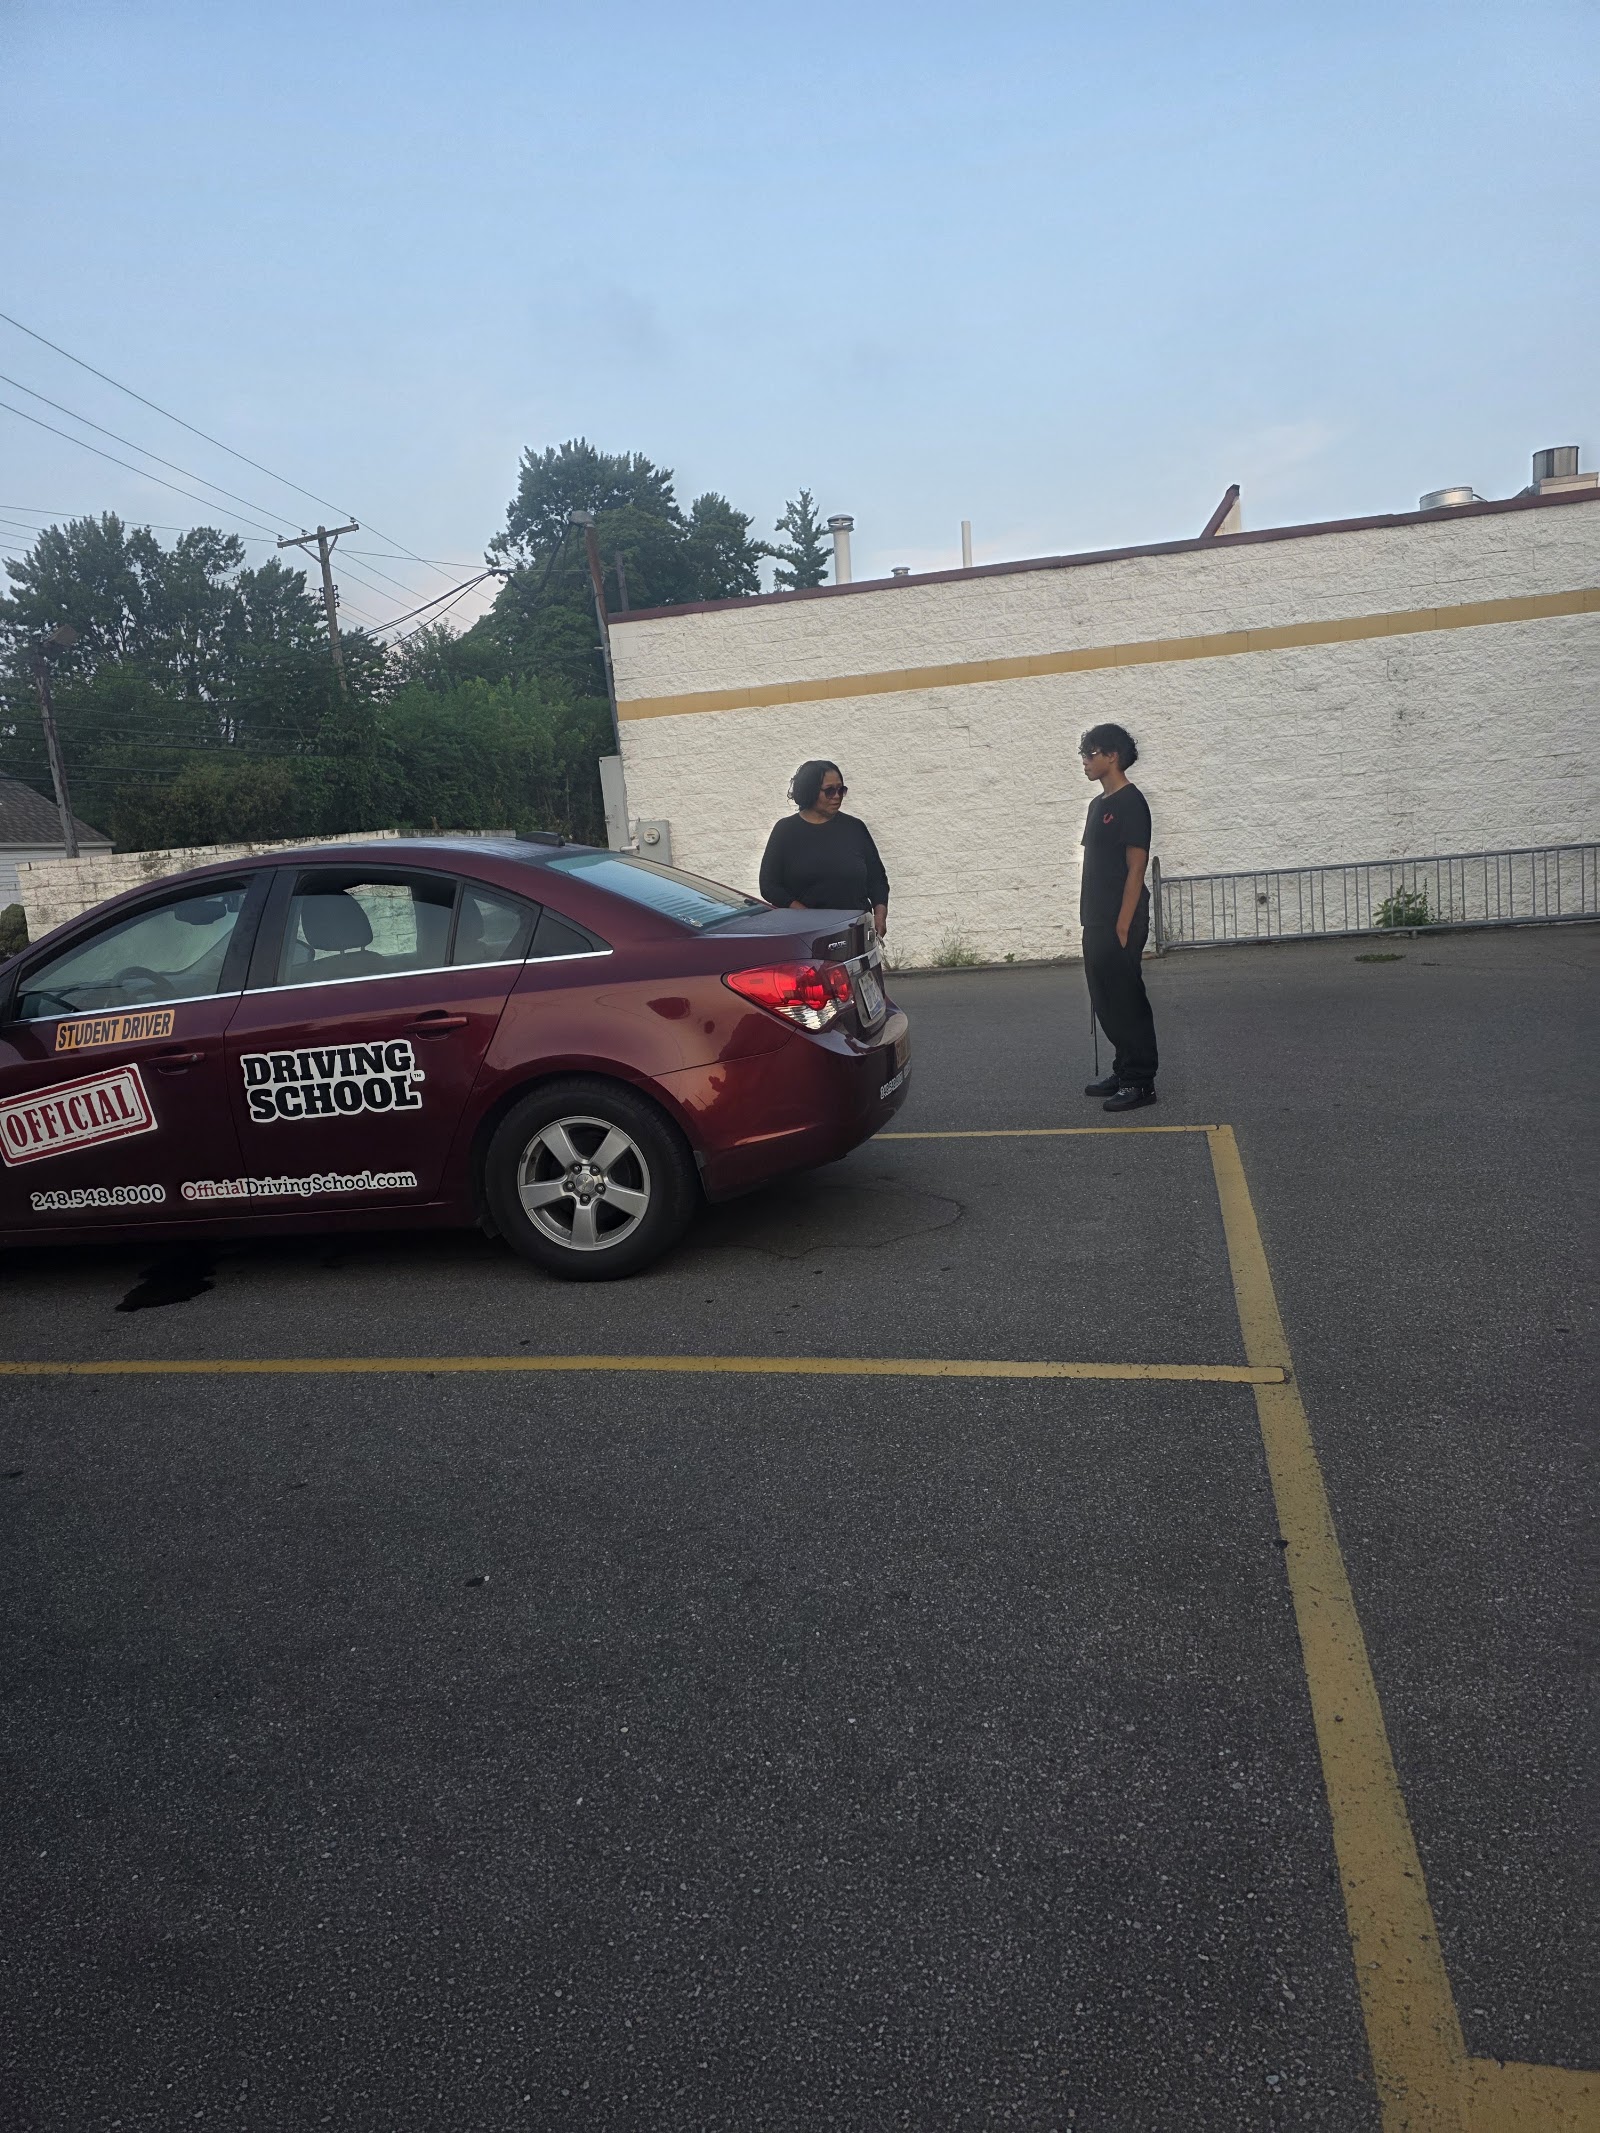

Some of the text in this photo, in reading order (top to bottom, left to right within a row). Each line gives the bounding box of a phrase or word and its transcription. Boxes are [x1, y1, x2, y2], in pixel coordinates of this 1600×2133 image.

[58, 1012, 171, 1048] STUDENT DRIVER
[243, 1042, 412, 1086] DRIVING
[6, 1084, 136, 1148] OFFICIAL
[249, 1075, 419, 1120] SCHOOL
[32, 1186, 164, 1208] 248.548.8000
[183, 1173, 416, 1199] OfficialDrivingSchool.com
